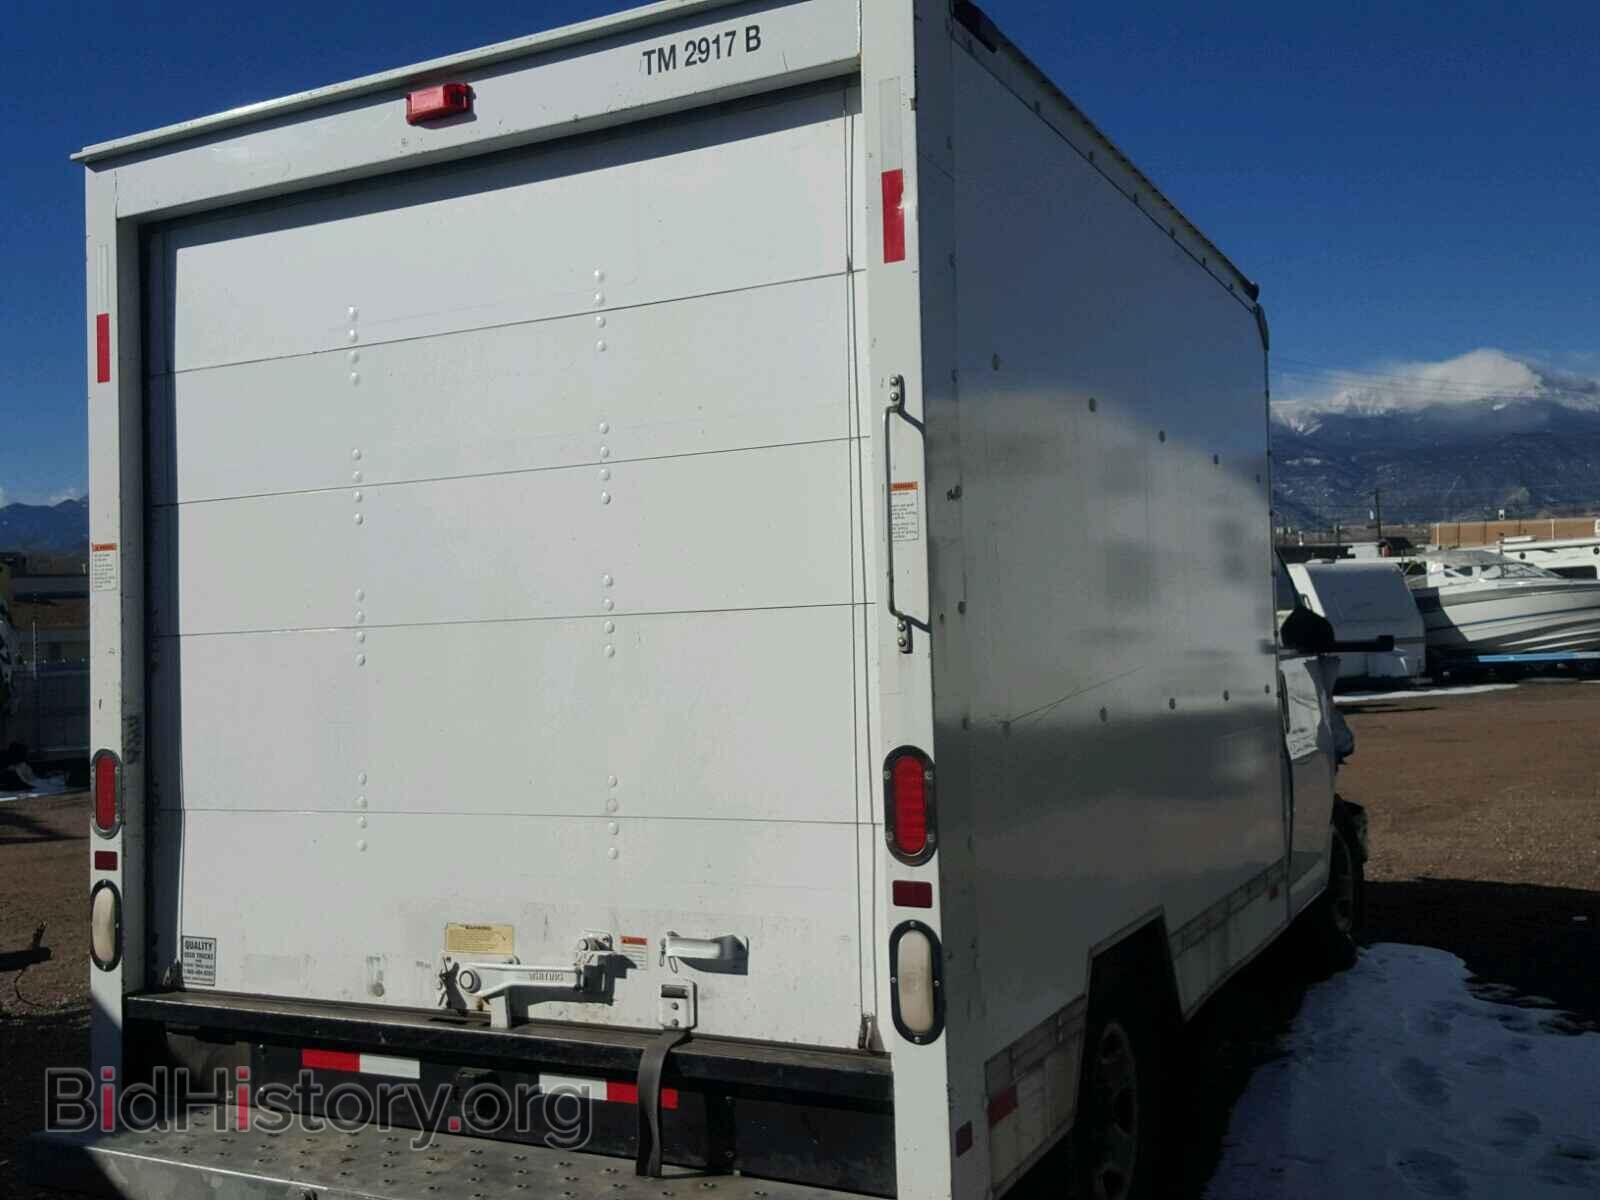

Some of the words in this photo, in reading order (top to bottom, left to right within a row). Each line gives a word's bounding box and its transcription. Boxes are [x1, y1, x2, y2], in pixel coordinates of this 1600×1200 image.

[642, 44, 677, 75] TM
[684, 30, 737, 67] 2917
[745, 24, 761, 53] B
[184, 940, 213, 950] QUALITY
